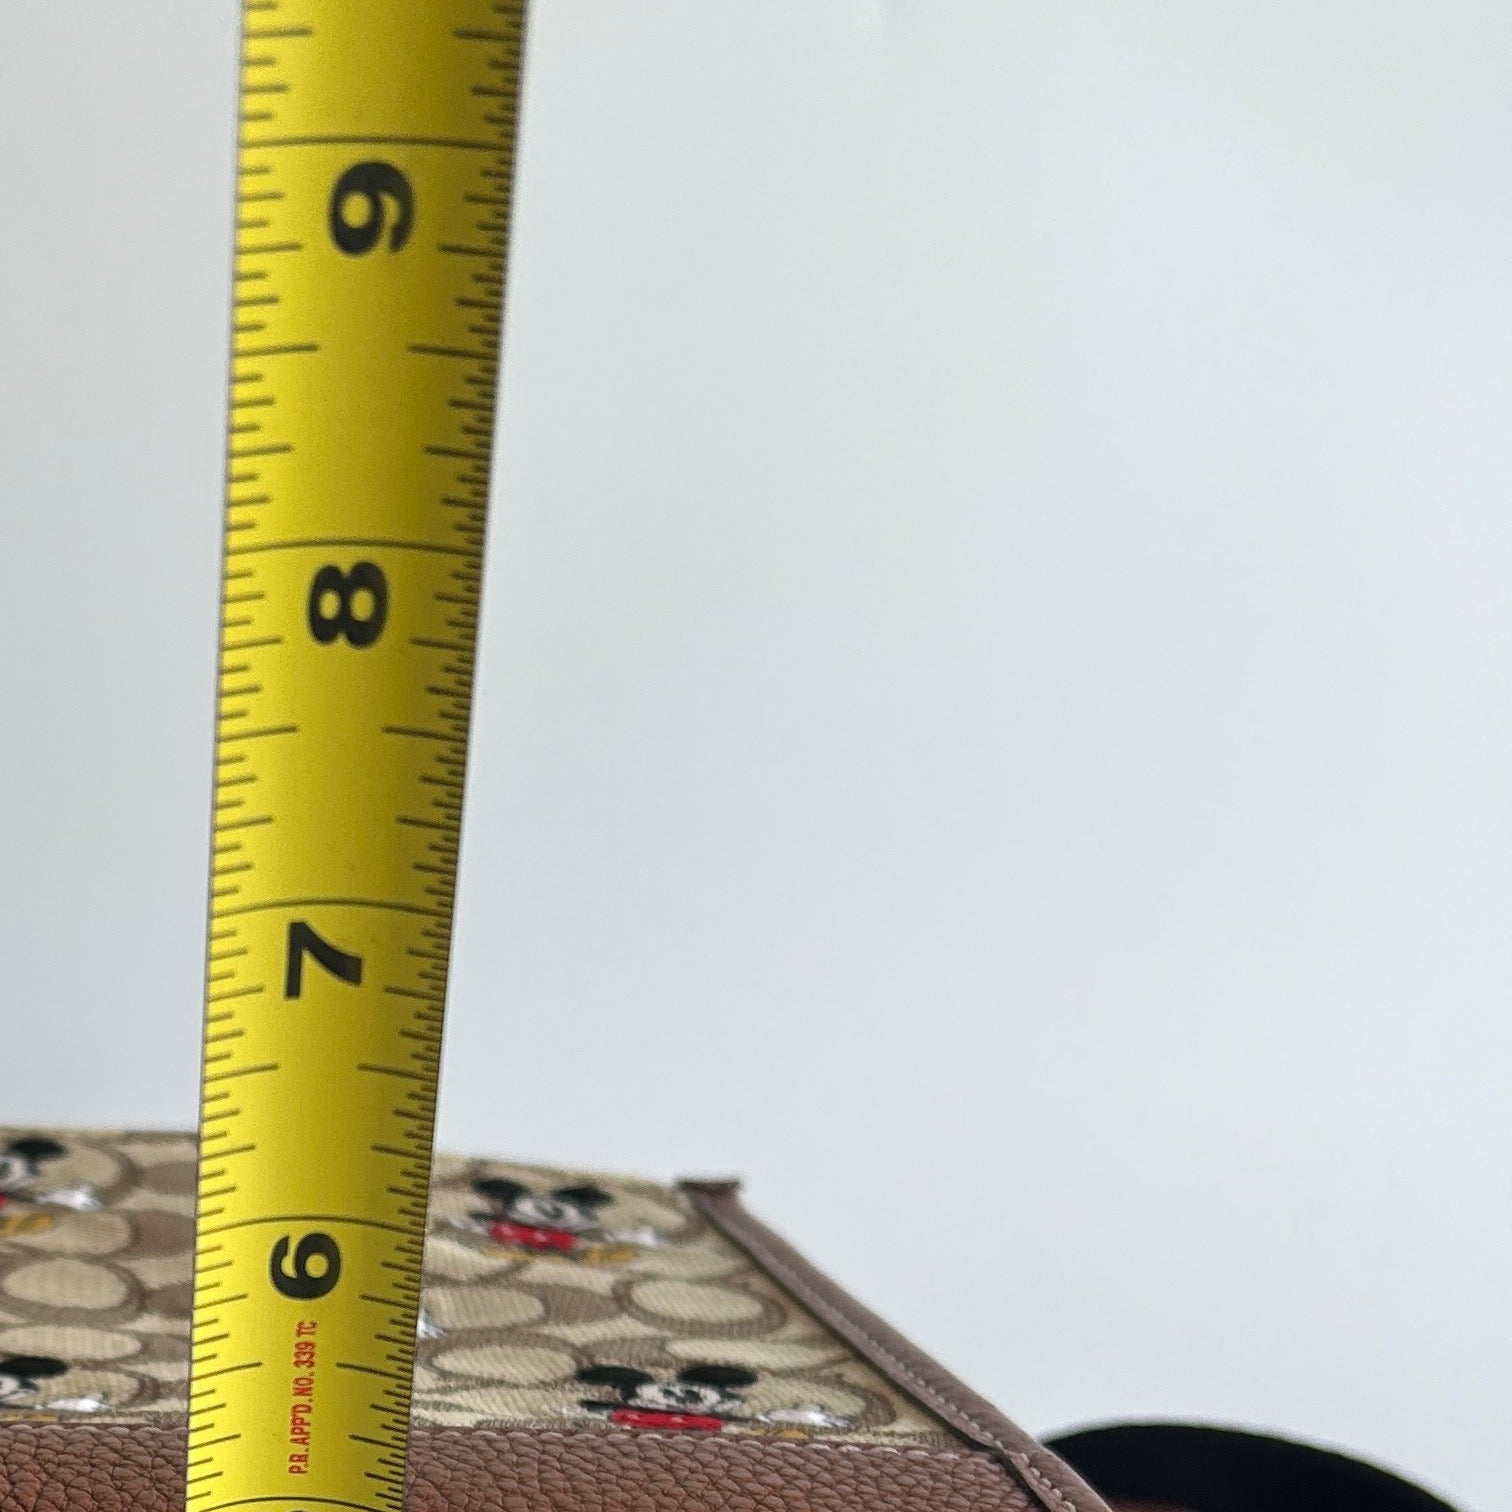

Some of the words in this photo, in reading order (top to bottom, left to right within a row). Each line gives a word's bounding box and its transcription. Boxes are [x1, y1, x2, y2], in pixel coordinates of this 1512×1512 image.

[328, 160, 415, 256] 9
[308, 561, 389, 650] 8
[284, 921, 364, 1000] 7
[271, 1232, 341, 1300] 6
